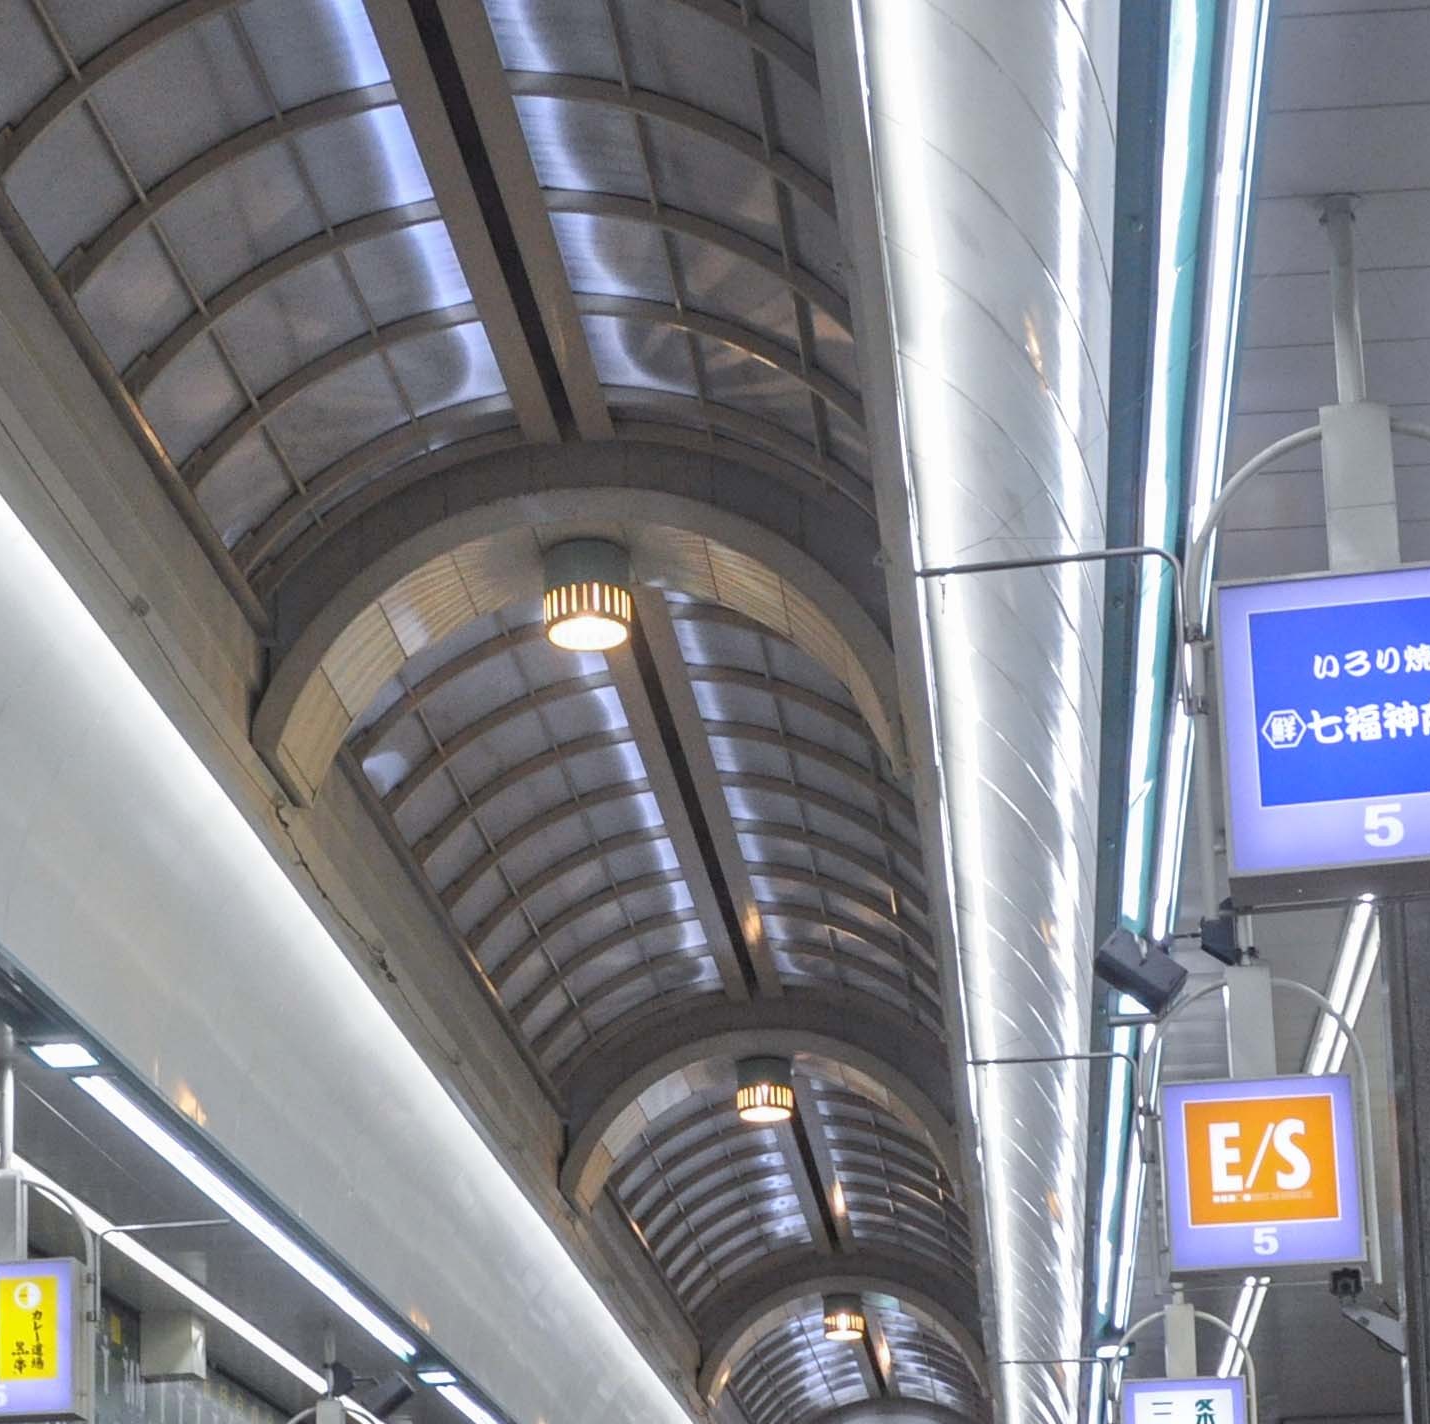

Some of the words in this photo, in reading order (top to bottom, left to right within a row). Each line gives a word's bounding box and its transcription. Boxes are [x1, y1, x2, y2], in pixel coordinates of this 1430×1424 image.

[1363, 804, 1406, 848] 5
[1207, 1118, 1312, 1194] E/S
[1253, 1227, 1279, 1255] 5
